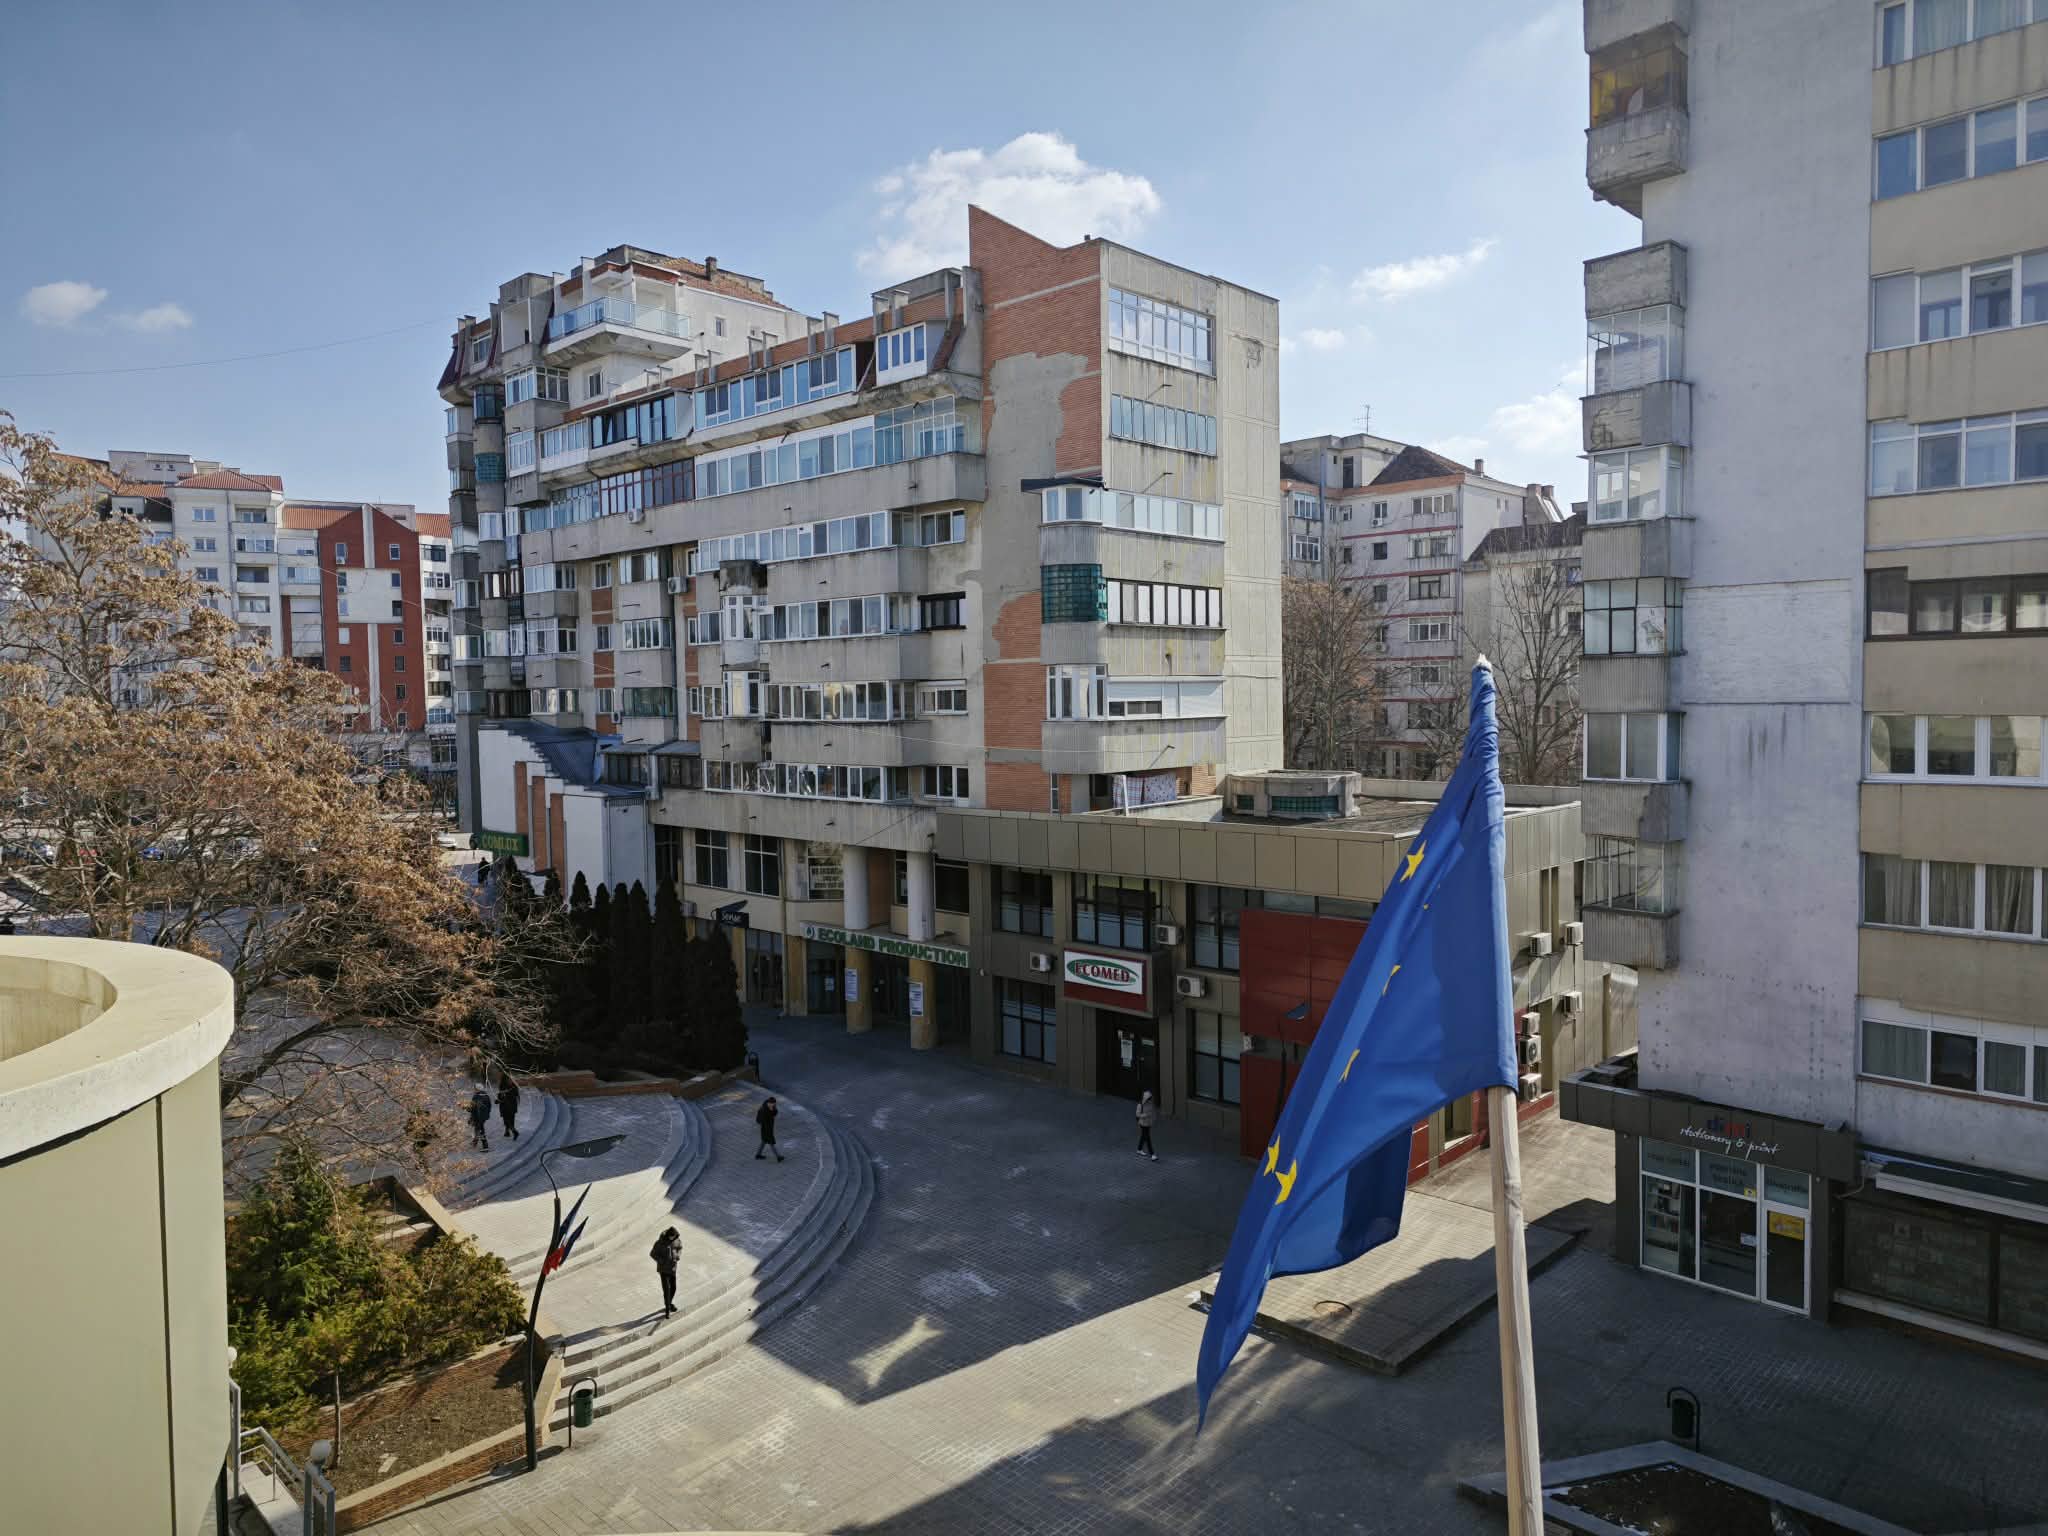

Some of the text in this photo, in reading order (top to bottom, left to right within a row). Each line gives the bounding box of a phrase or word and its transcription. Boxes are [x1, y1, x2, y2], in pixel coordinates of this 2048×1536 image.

[818, 927, 967, 967] ECOLAND PRODUCTION
[1074, 962, 1131, 983] ECOMED
[1735, 1137, 1746, 1148] &
[1744, 1140, 1782, 1161] print
